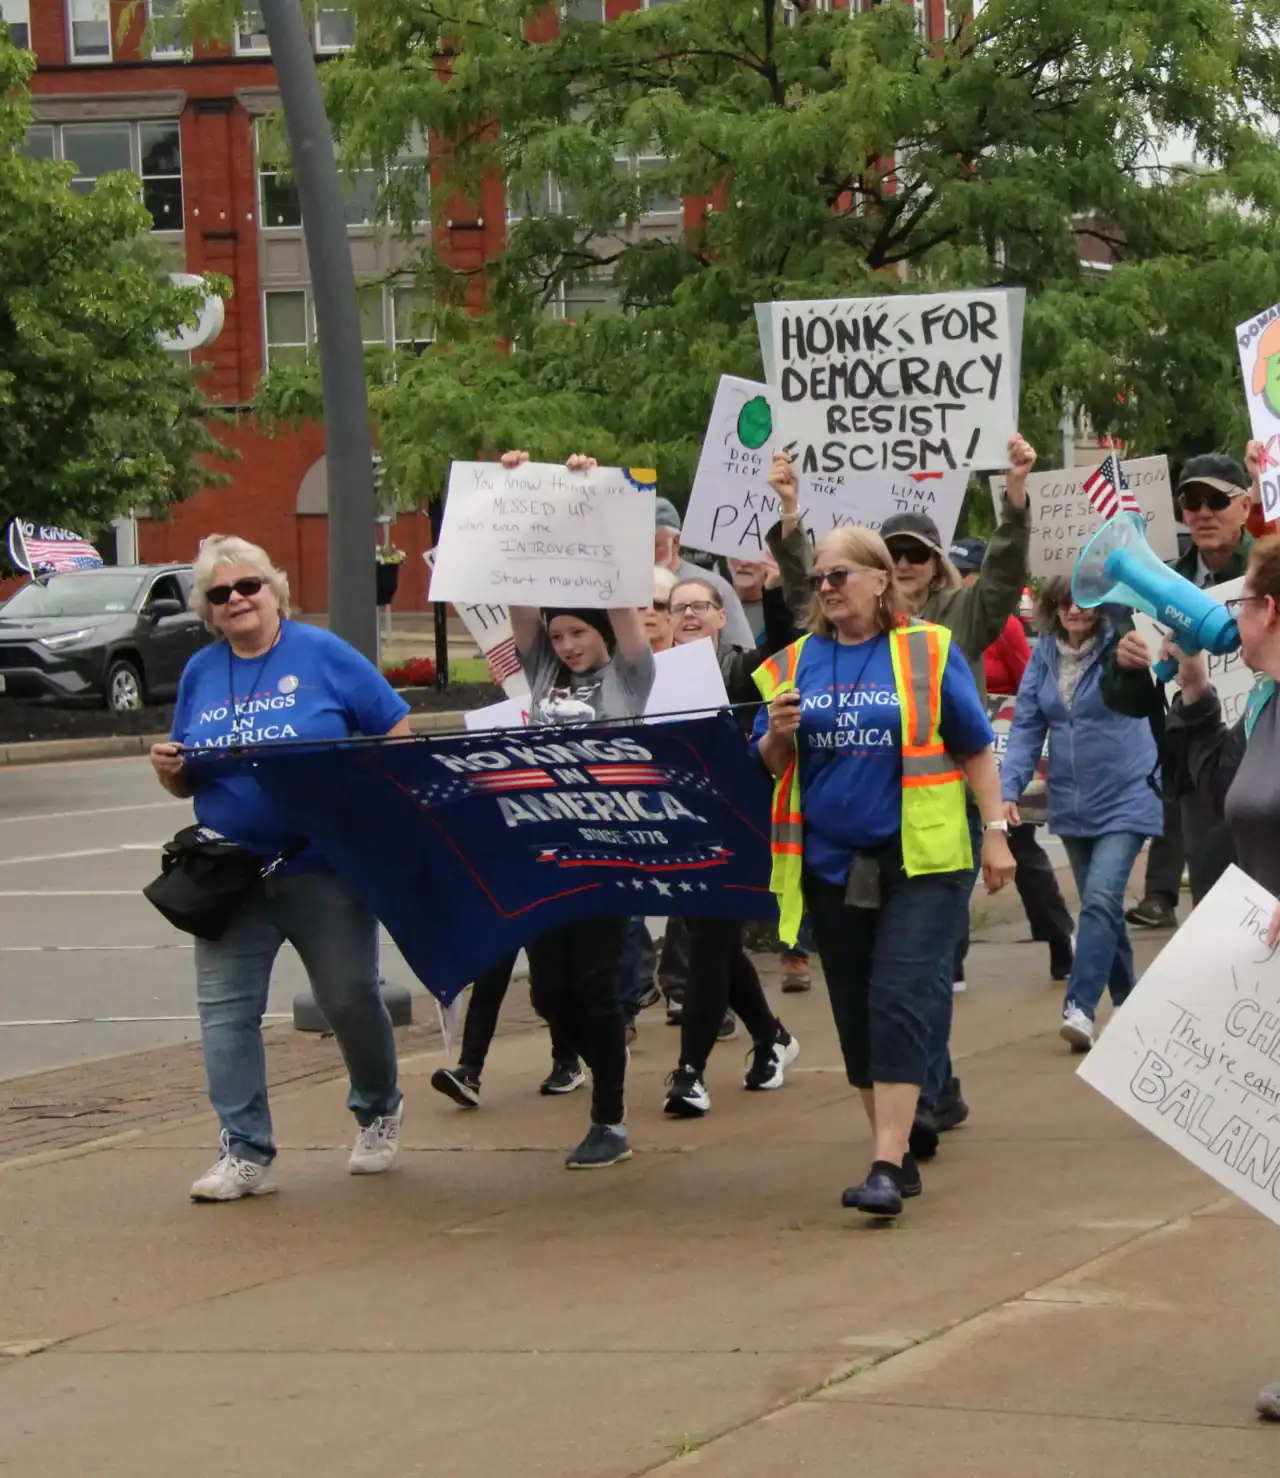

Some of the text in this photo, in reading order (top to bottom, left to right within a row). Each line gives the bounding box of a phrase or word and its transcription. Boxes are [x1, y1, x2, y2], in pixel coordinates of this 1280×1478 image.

[782, 301, 999, 360] HONK FOR
[781, 353, 1003, 402] DEMOCRACY
[826, 403, 966, 436] RESIST
[730, 448, 762, 465] DOG
[723, 462, 761, 477] TICK
[474, 469, 495, 489] You
[550, 472, 597, 502] things
[604, 485, 626, 496] are
[811, 482, 837, 496] TICK
[891, 483, 936, 503] LUNA
[457, 519, 553, 533] when even the
[500, 539, 615, 558] INTROVERTS
[490, 570, 538, 586] Start
[1164, 603, 1194, 629] PYLE
[200, 694, 296, 724] NO KINGS
[802, 691, 900, 711] NO KINGS
[231, 716, 255, 732] IN
[836, 711, 860, 727] IN
[192, 723, 299, 757] AMERICA
[808, 728, 895, 749] AMERICA
[431, 737, 653, 773] NO KINGS
[553, 768, 590, 785] IN
[578, 826, 622, 845] SINCE
[1167, 1000, 1235, 1075] They're
